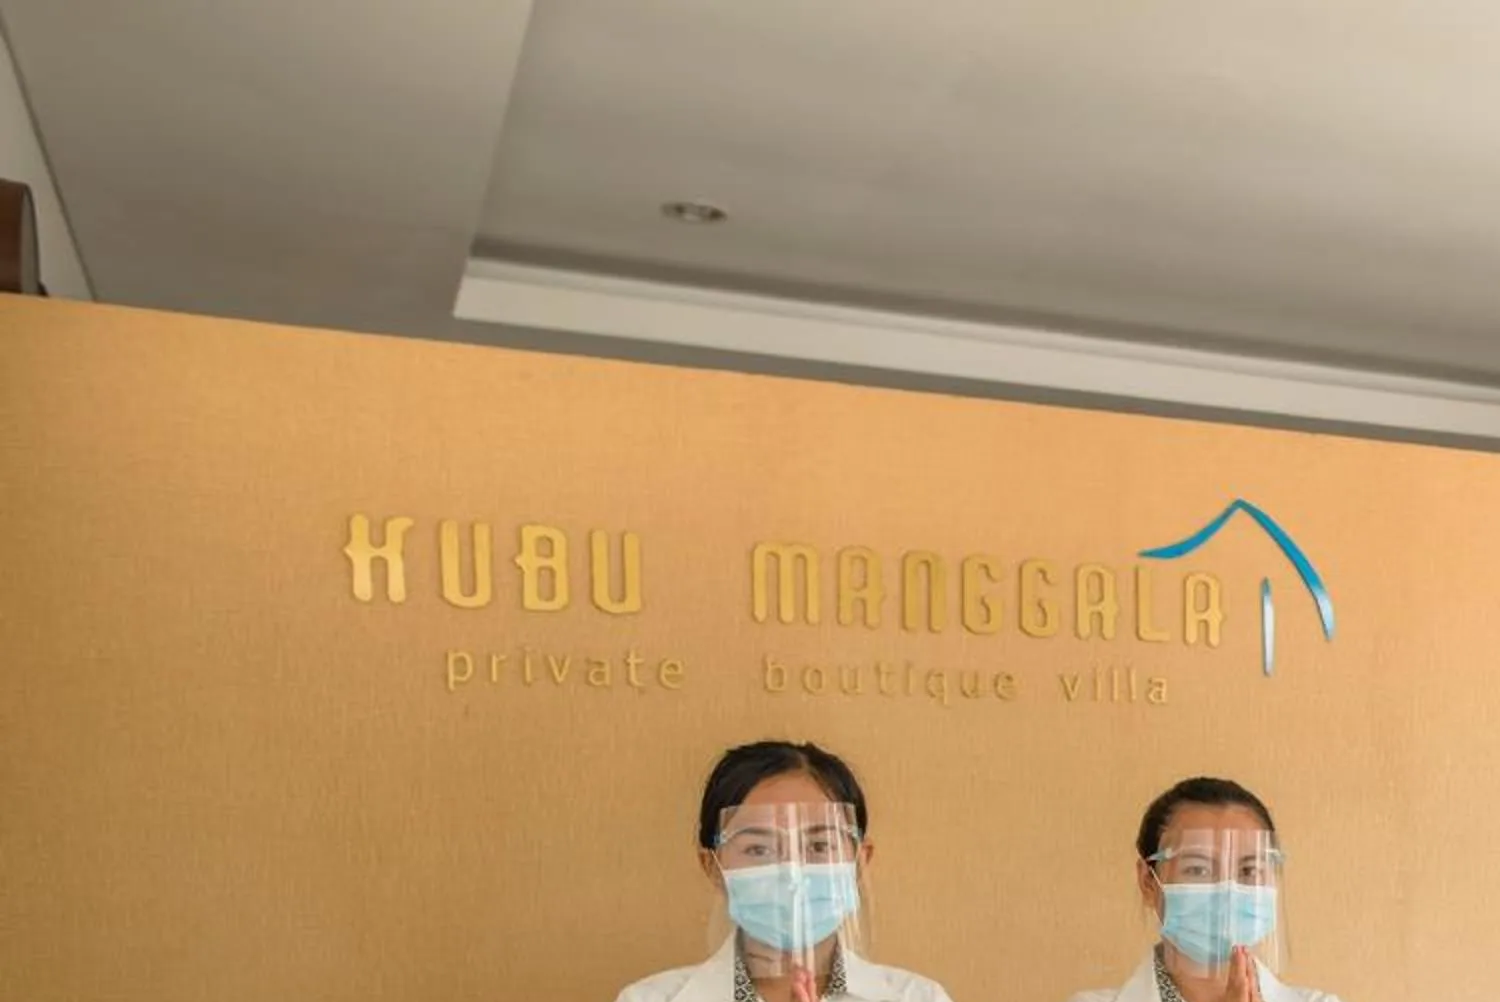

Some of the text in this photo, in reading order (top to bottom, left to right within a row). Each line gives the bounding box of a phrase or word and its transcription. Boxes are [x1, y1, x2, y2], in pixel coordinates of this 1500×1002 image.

[343, 513, 1227, 648] HUBU MANGGALA
[446, 648, 1169, 704] private boutique villa
